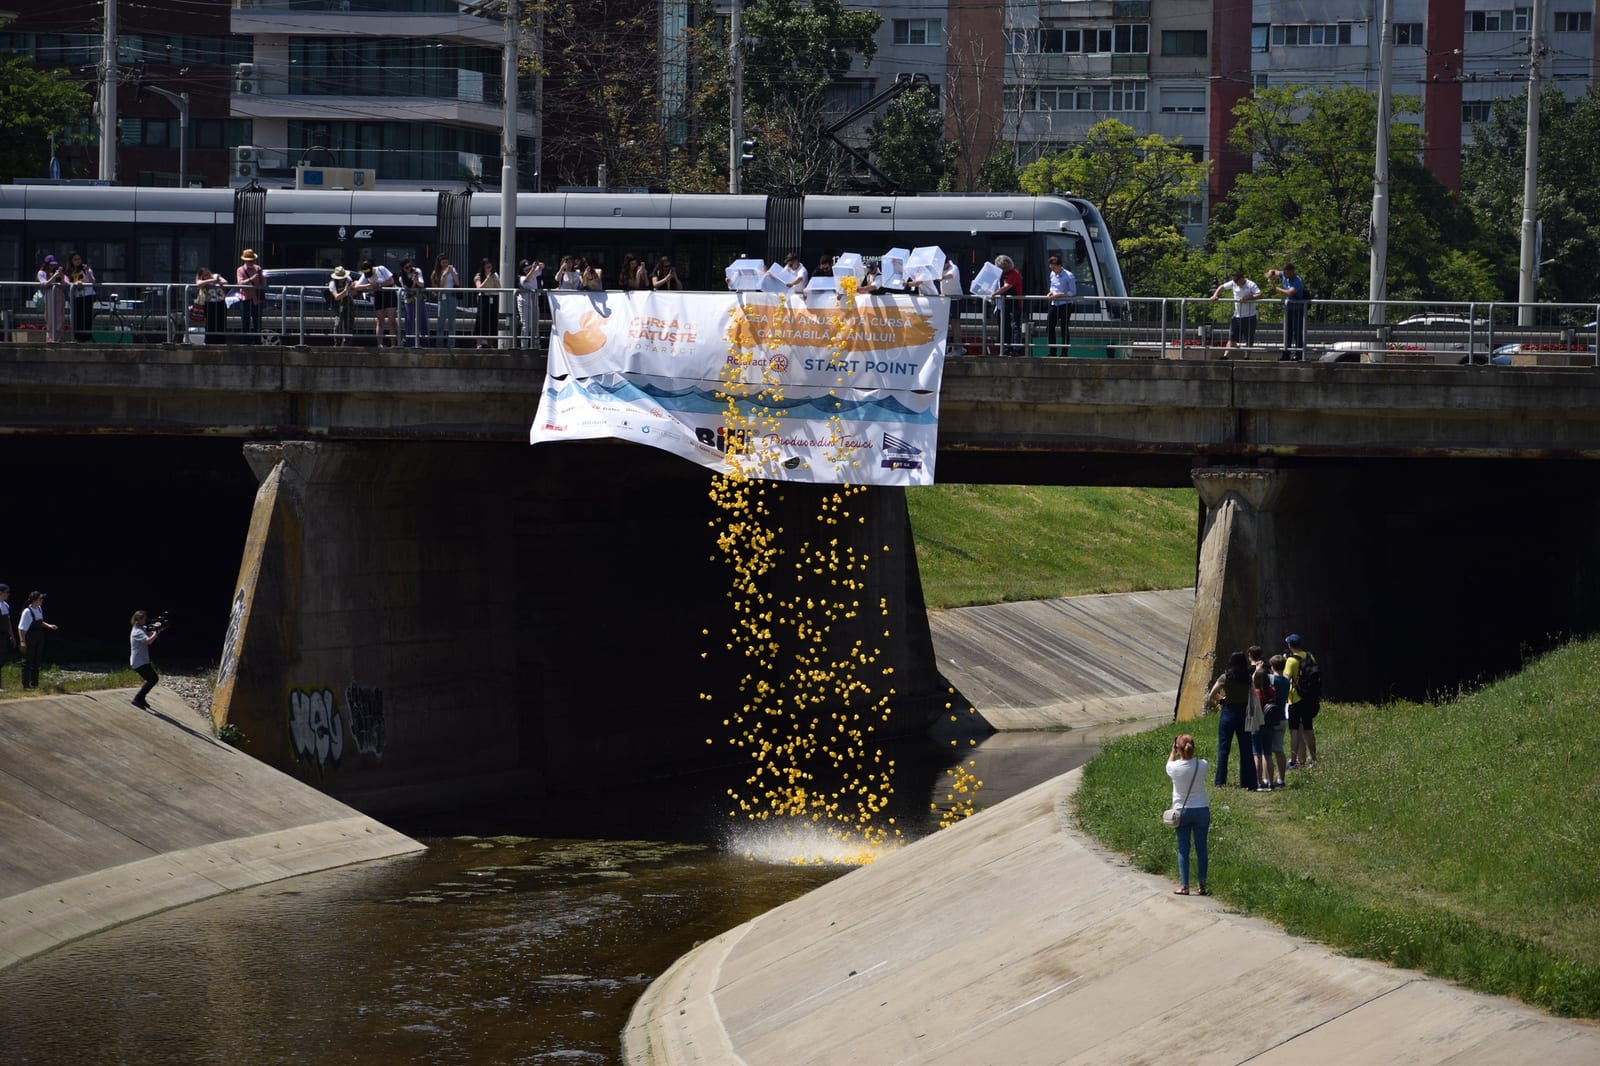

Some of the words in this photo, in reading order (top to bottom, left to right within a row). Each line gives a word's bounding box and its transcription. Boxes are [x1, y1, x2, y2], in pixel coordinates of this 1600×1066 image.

[630, 316, 679, 329] CURSA
[798, 314, 867, 326] AMUZNTĂ
[804, 359, 860, 373] START
[865, 360, 918, 375] POINT
